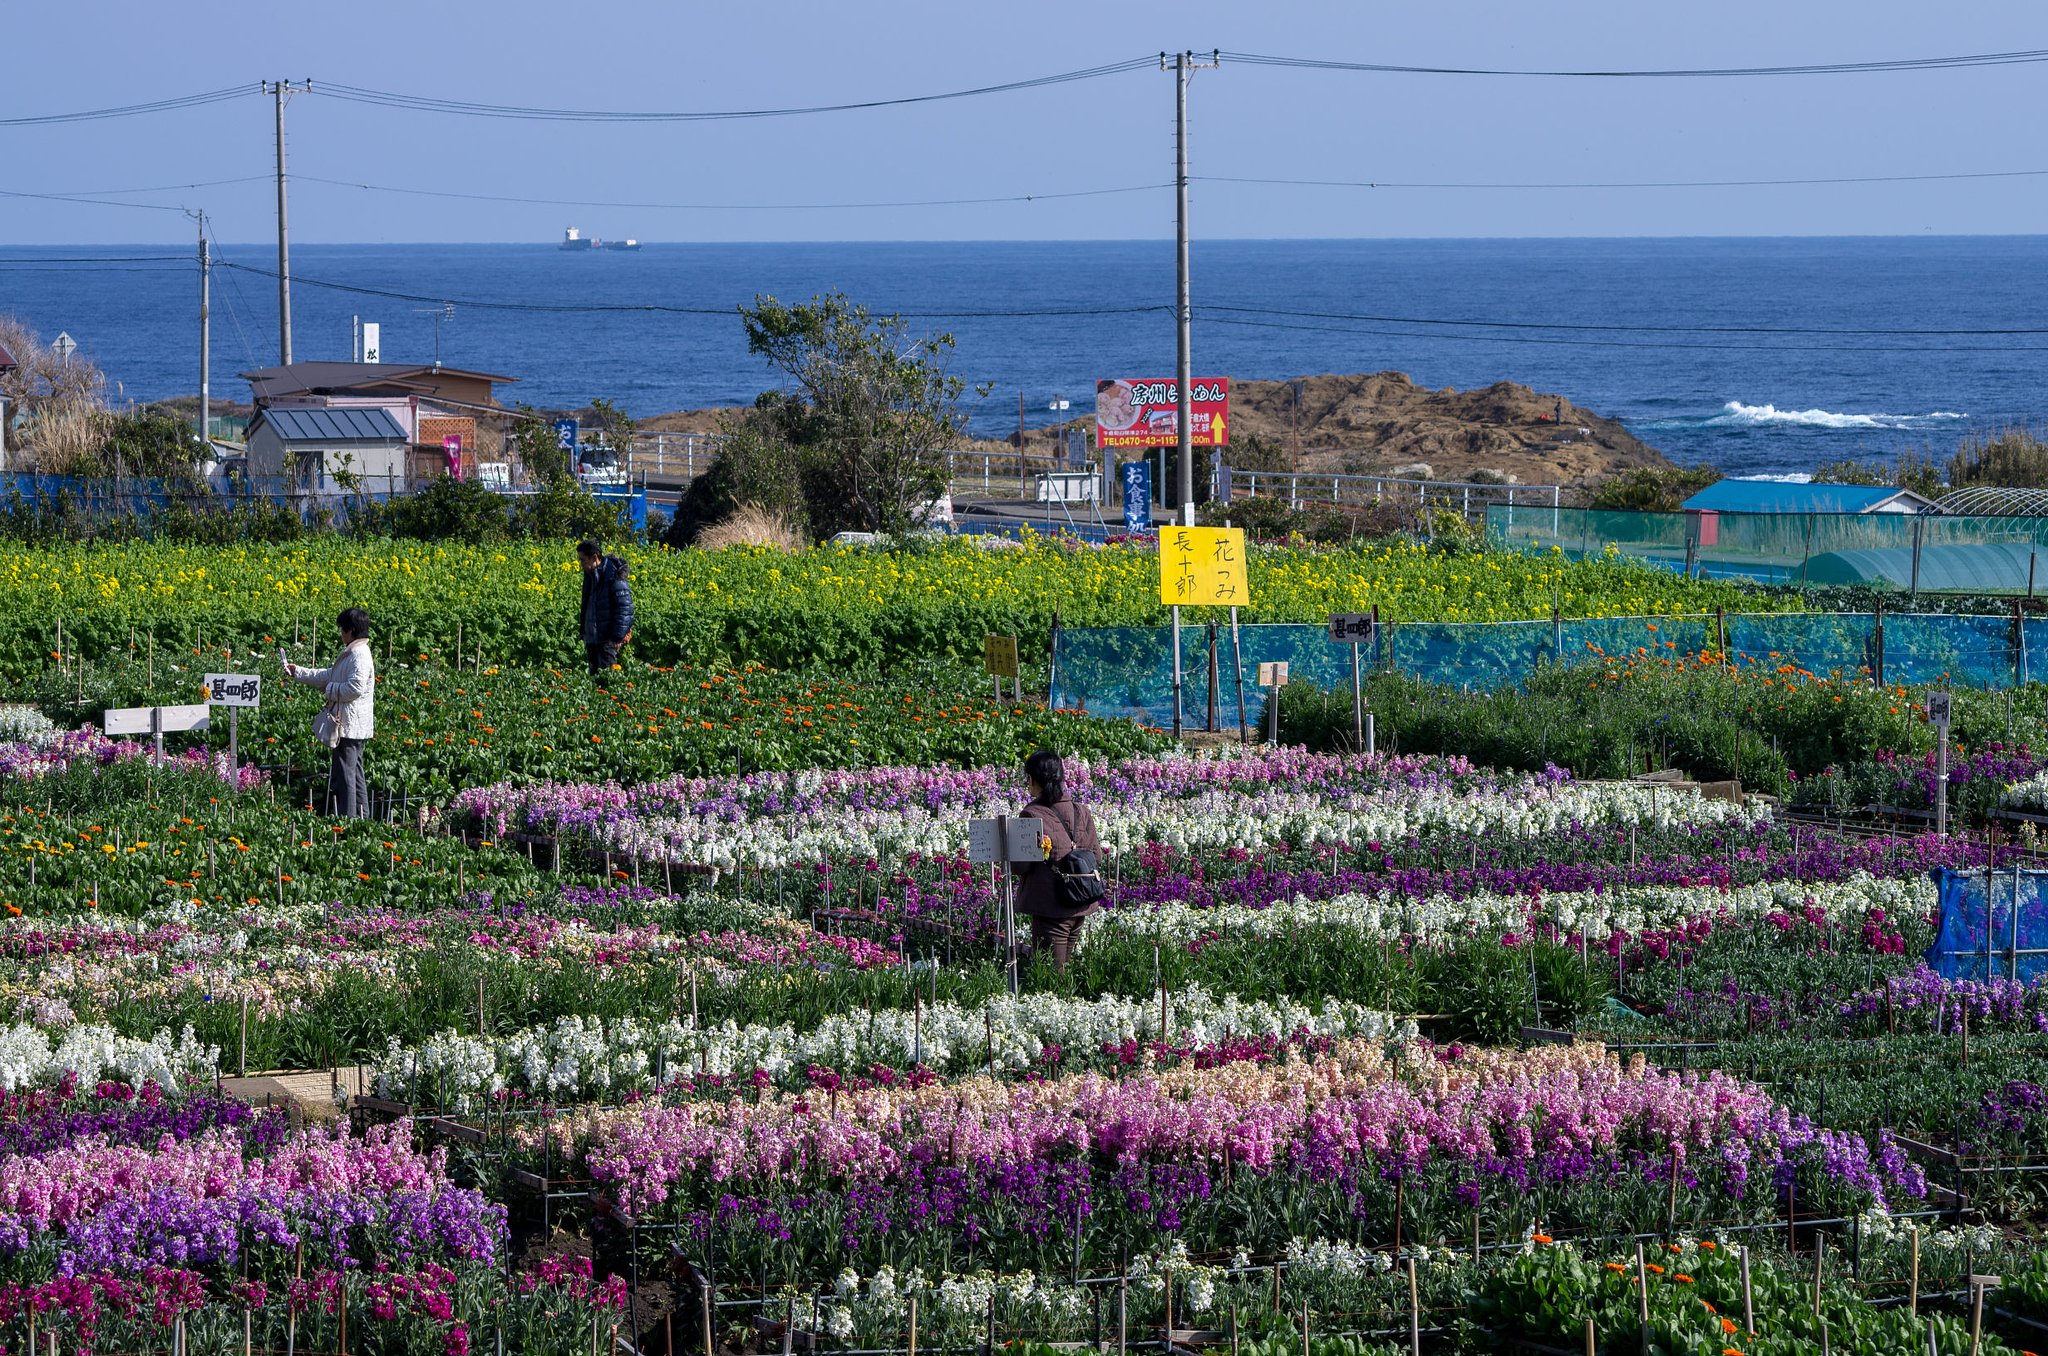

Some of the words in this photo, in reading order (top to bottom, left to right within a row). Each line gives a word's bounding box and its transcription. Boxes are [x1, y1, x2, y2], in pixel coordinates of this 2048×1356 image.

[1131, 383, 1226, 406] 房州らめん
[1127, 467, 1146, 534] お食事処
[1173, 531, 1197, 602] 長十郎
[1213, 538, 1236, 599] 花つみ
[211, 678, 258, 701] 甚四郎
